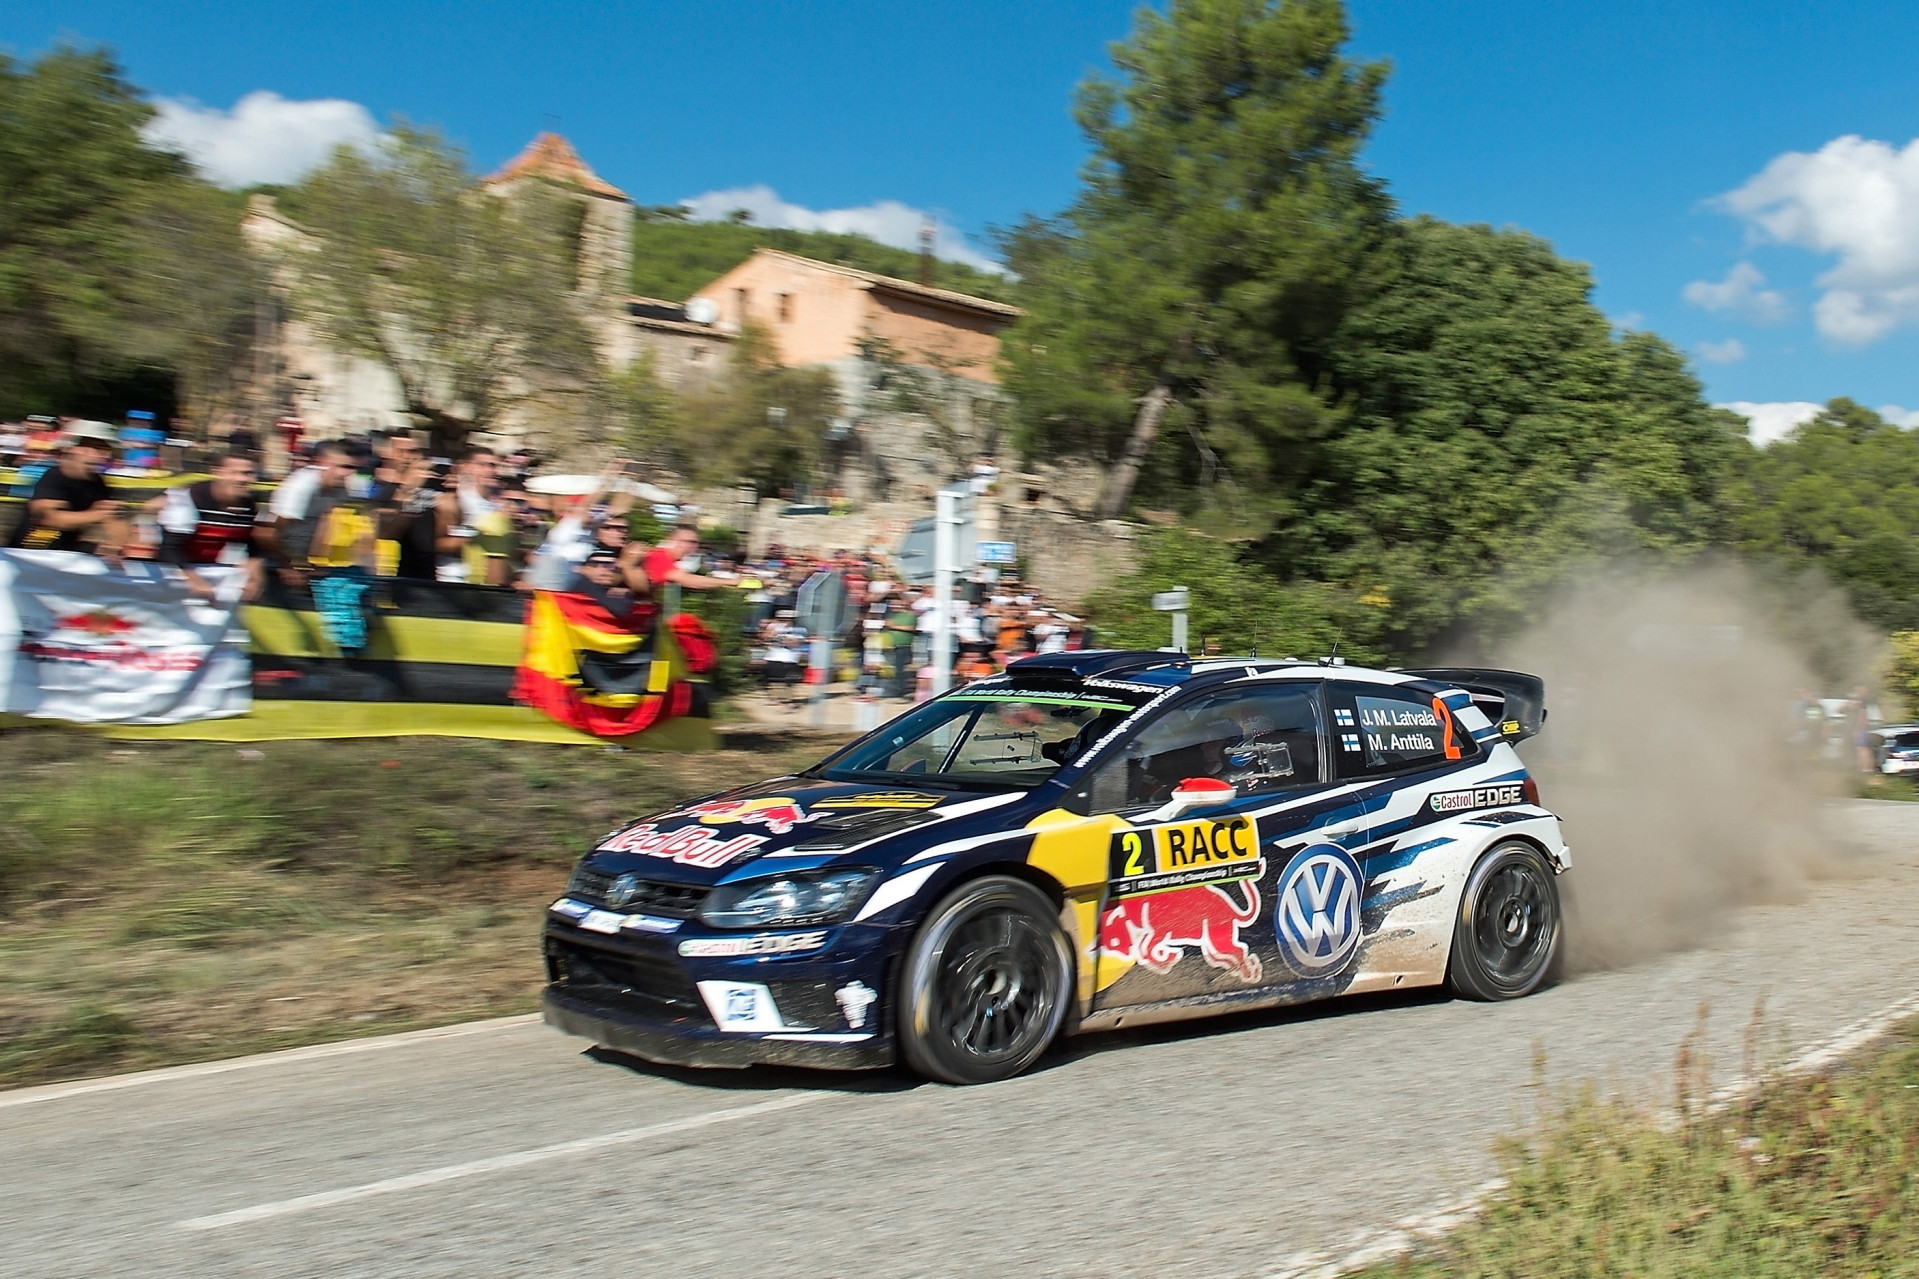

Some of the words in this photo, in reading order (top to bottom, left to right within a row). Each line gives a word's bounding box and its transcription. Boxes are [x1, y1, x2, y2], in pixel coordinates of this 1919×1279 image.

[1083, 680, 1164, 693] Volkswagen
[1392, 709, 1437, 727] Latvala
[1432, 697, 1461, 759] 2
[1368, 734, 1387, 750] M.
[1390, 734, 1434, 750] Anttila
[1440, 793, 1473, 809] Castrol
[1474, 786, 1522, 807] EDGE
[1122, 832, 1145, 877] 2
[1169, 820, 1248, 867] RACC
